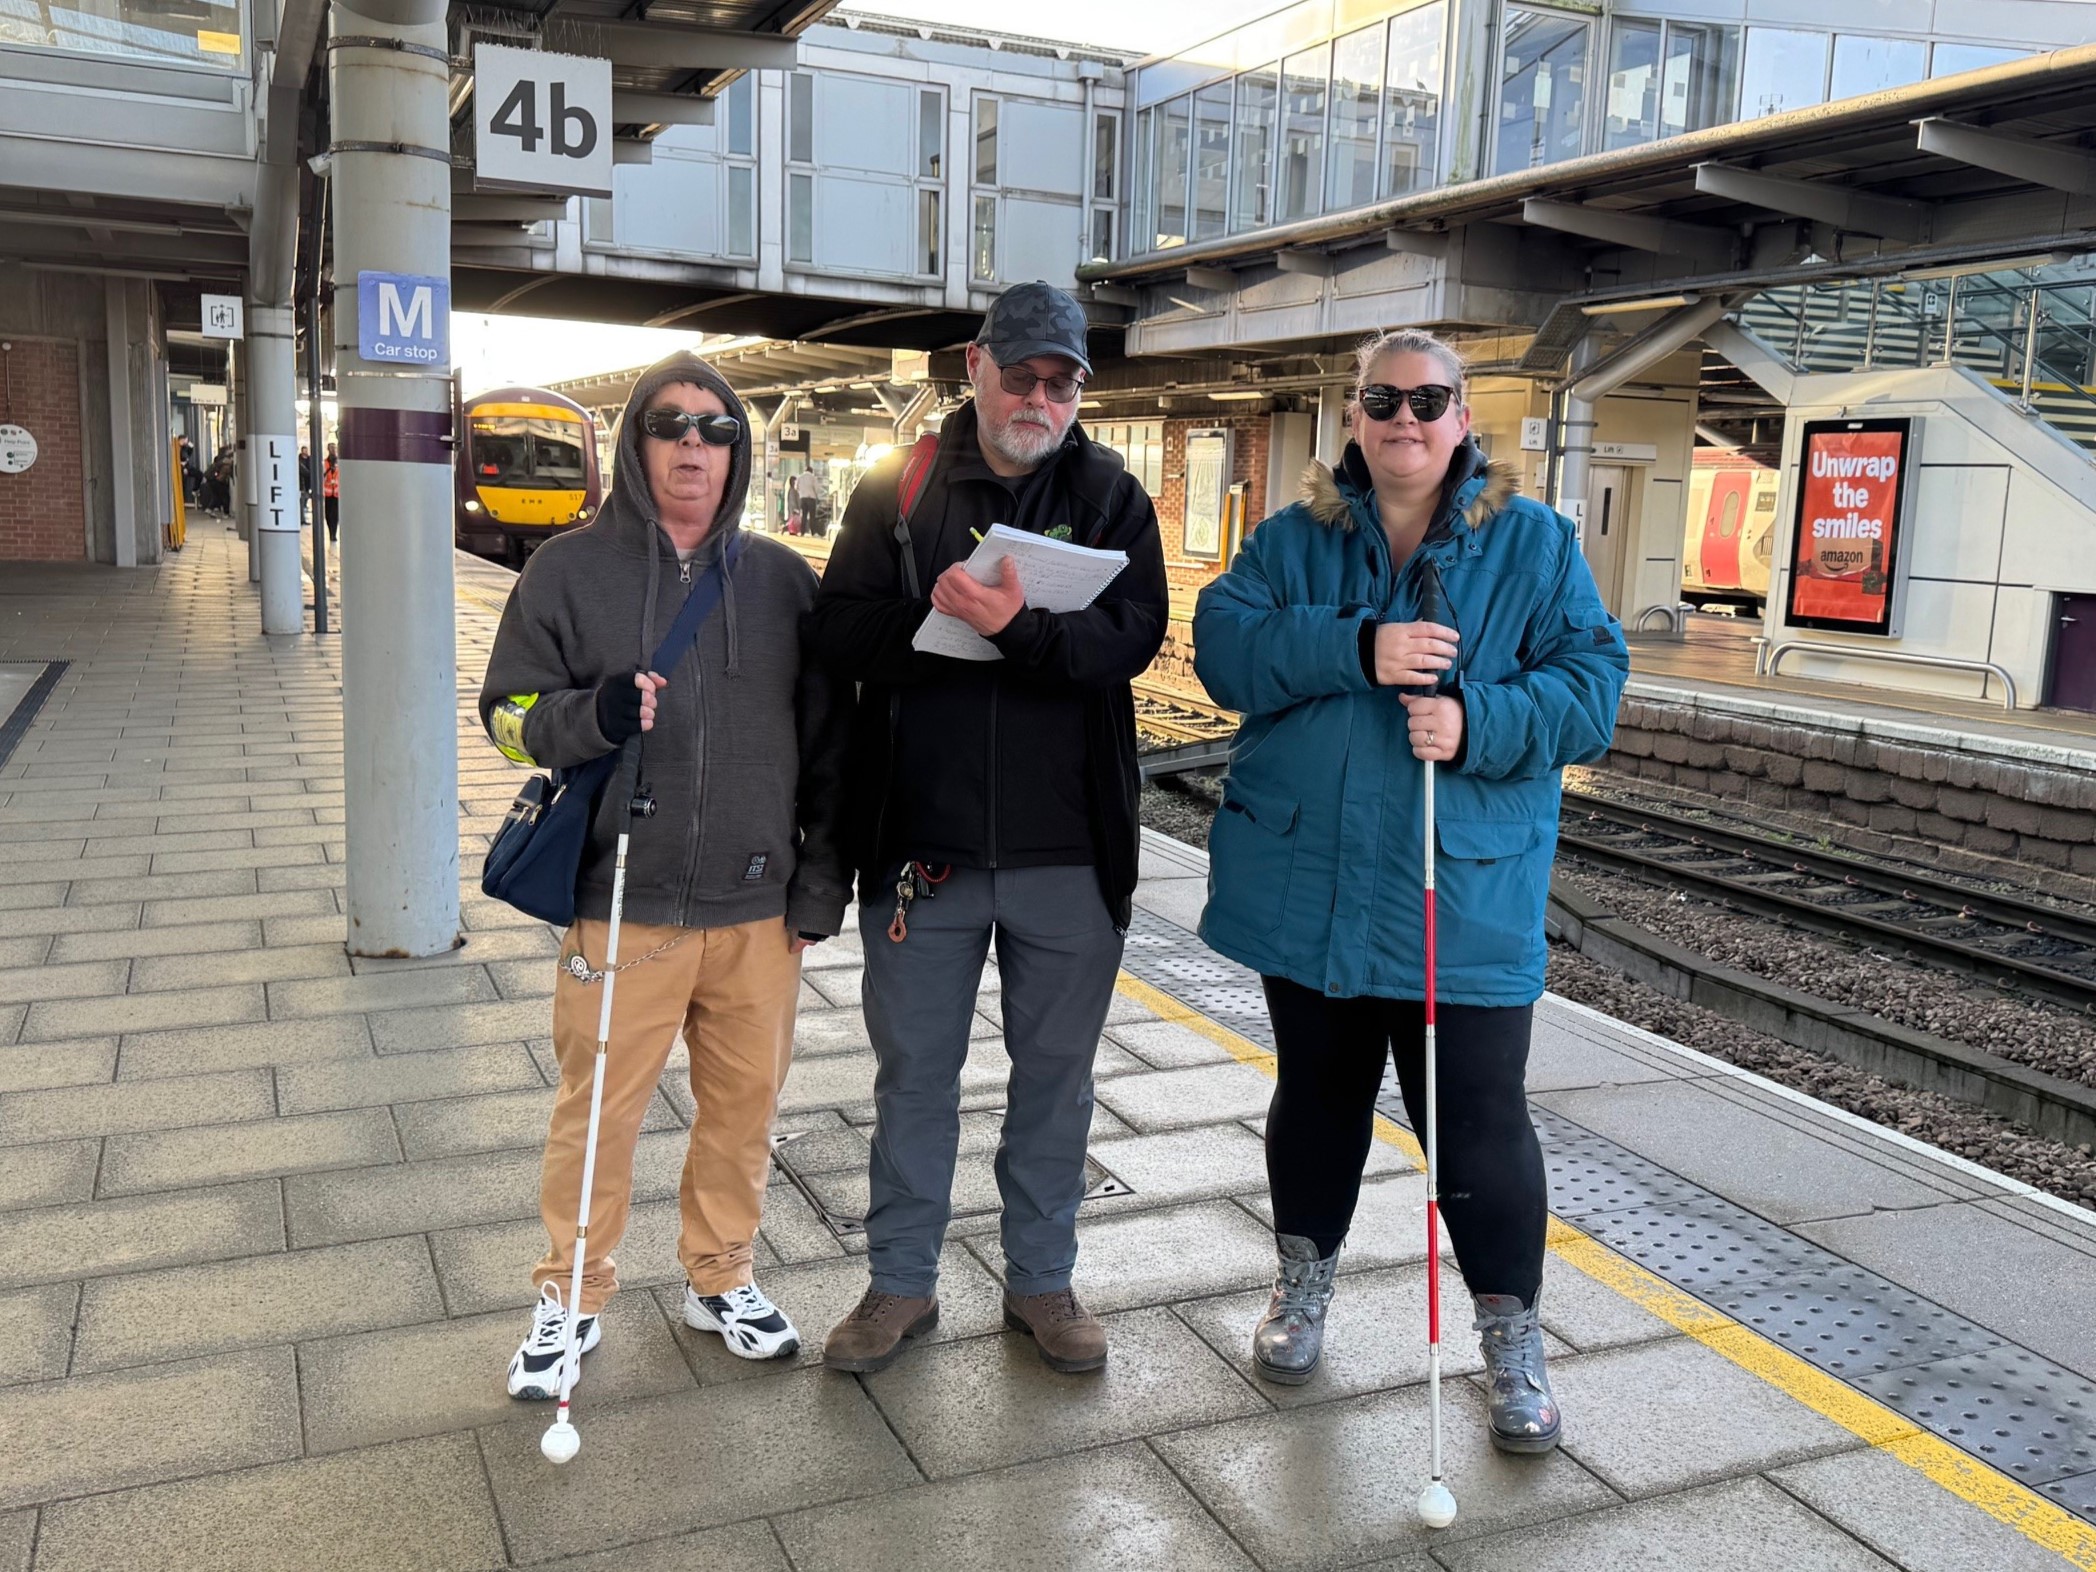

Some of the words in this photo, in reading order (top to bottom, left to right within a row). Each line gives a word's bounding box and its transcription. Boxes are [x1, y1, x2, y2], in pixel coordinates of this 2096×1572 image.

[490, 79, 598, 159] 4b
[379, 282, 432, 339] M
[374, 342, 402, 357] Car
[404, 345, 438, 361] stop
[784, 426, 797, 437] 3a
[1604, 445, 1614, 453] Lift
[1811, 451, 1896, 482] Unwrap
[269, 440, 284, 526] LIFT
[1832, 482, 1869, 509] the
[1811, 512, 1883, 539] smiles
[1820, 549, 1864, 564] amazon
